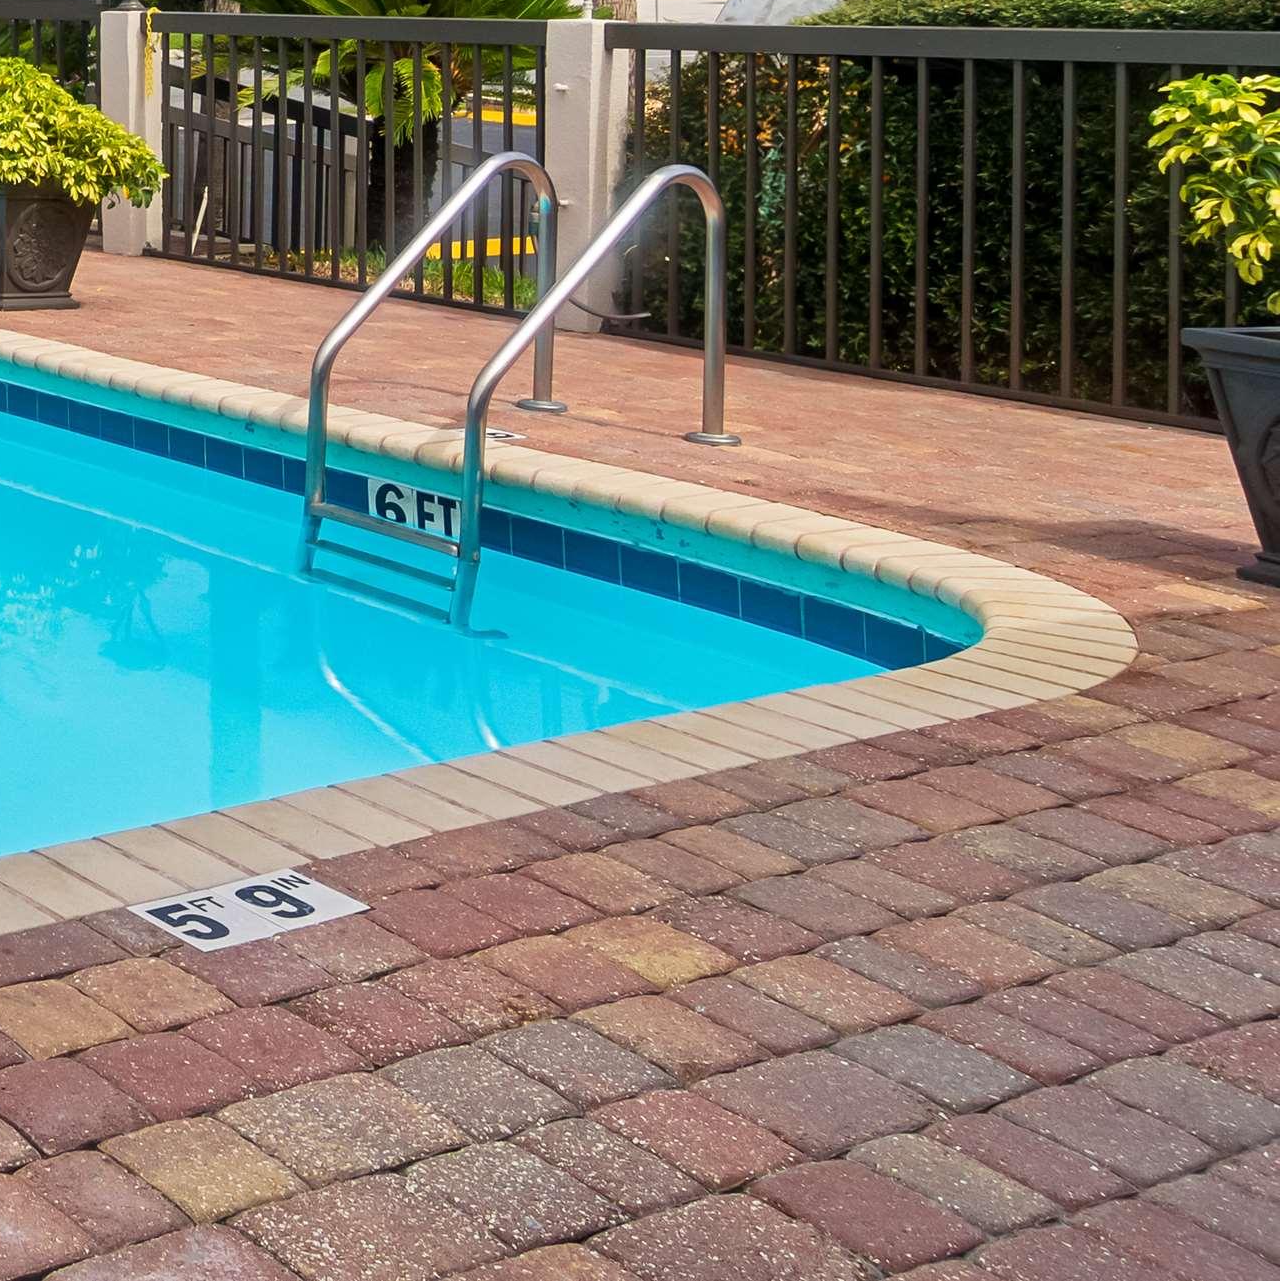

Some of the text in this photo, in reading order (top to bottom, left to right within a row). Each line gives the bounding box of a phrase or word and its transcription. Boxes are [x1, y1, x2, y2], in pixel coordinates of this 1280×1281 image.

[375, 483, 457, 538] 6 FT
[145, 874, 316, 941] 5 FT 9 IN
